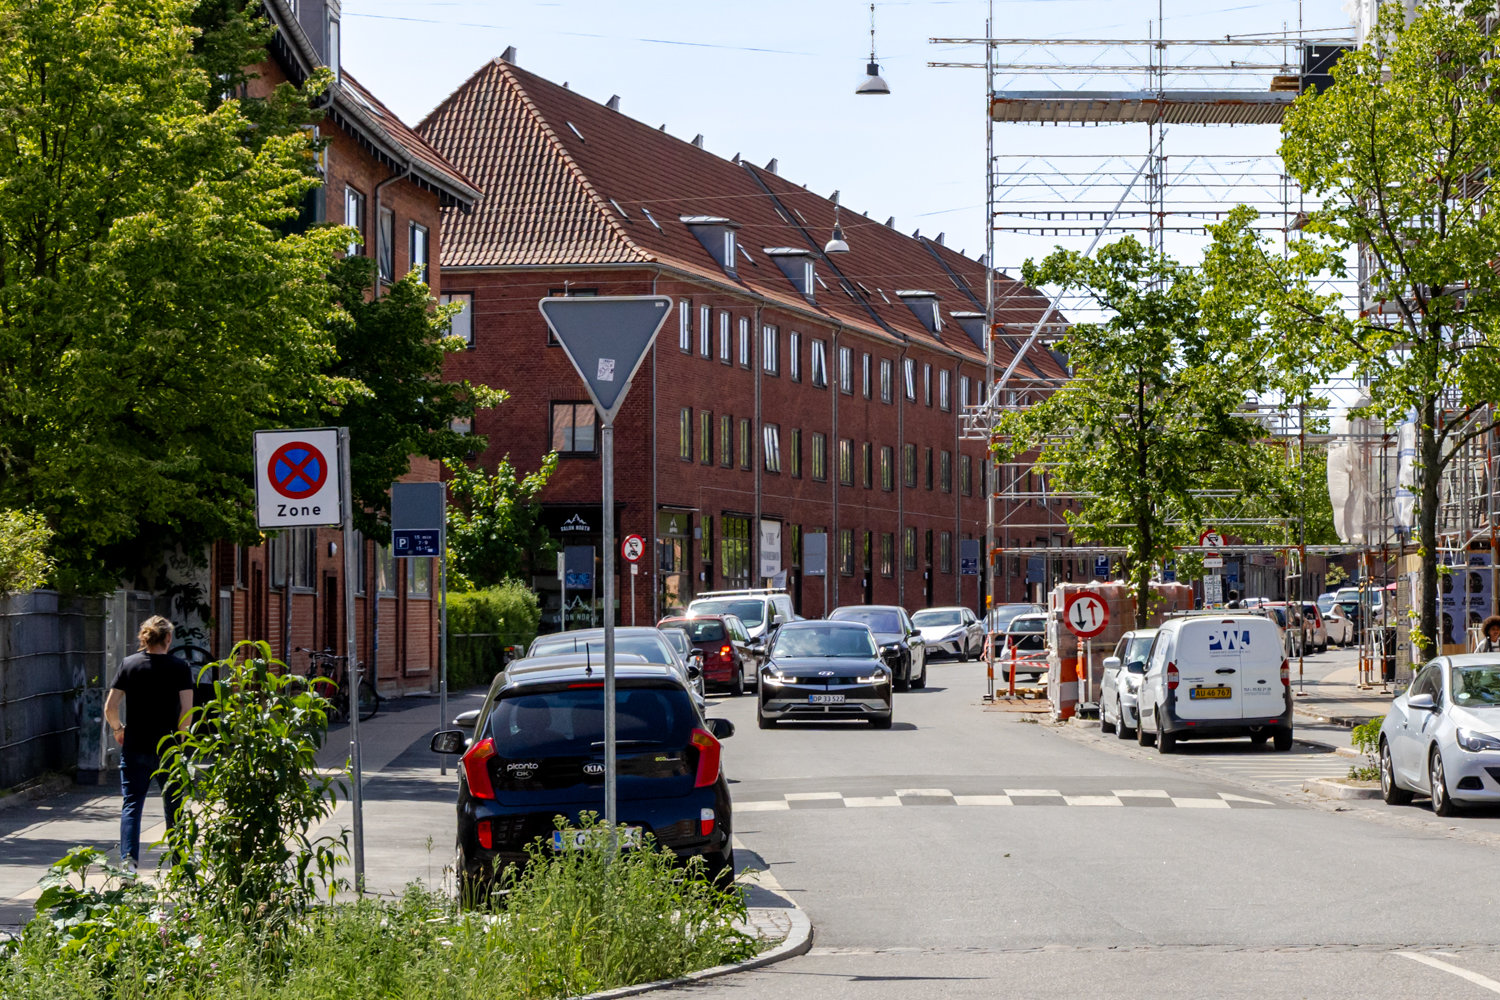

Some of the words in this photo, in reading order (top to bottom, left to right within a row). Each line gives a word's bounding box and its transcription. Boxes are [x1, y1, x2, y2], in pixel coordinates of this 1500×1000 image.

[277, 504, 320, 517] Zone
[399, 538, 406, 547] P
[507, 762, 538, 771] picanto
[588, 765, 603, 773] KIA
